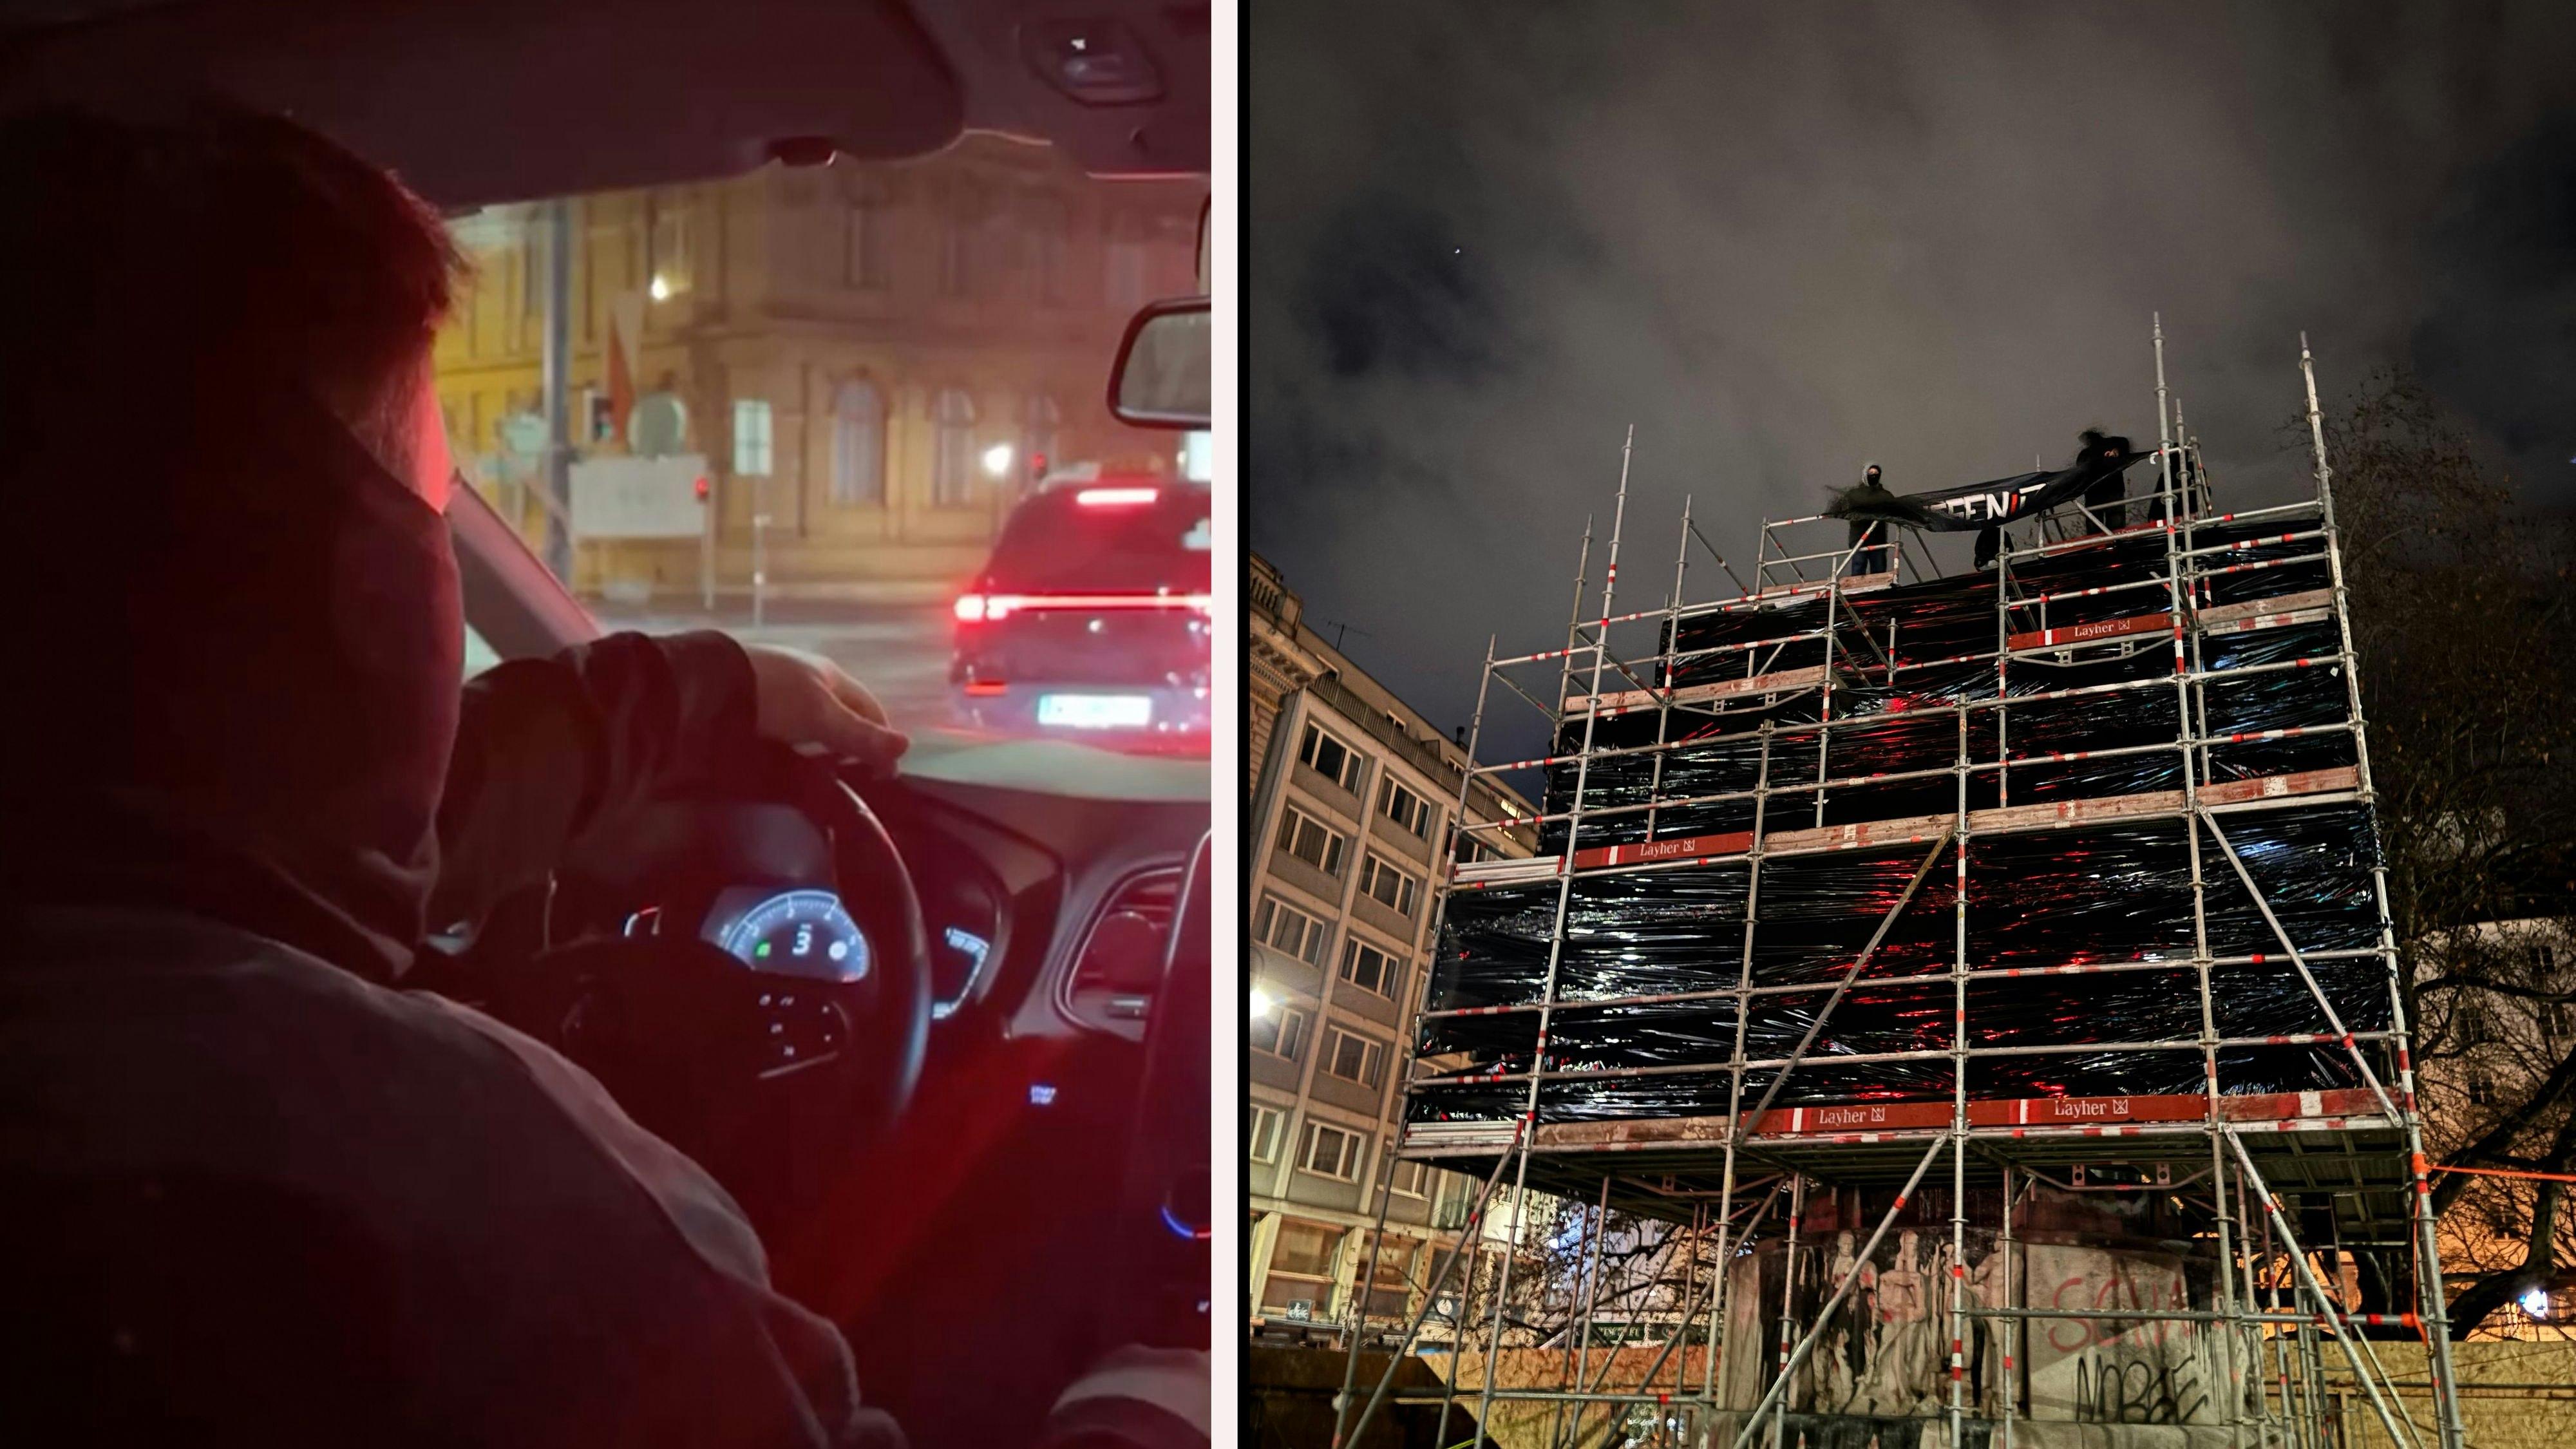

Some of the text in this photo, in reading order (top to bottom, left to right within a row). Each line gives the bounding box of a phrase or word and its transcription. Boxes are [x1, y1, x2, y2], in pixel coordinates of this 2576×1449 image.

[2074, 623, 2114, 637] Layher
[1640, 842, 1680, 858] Layher
[2054, 1099, 2107, 1119] Layher
[1819, 1109, 1866, 1126] Layher
